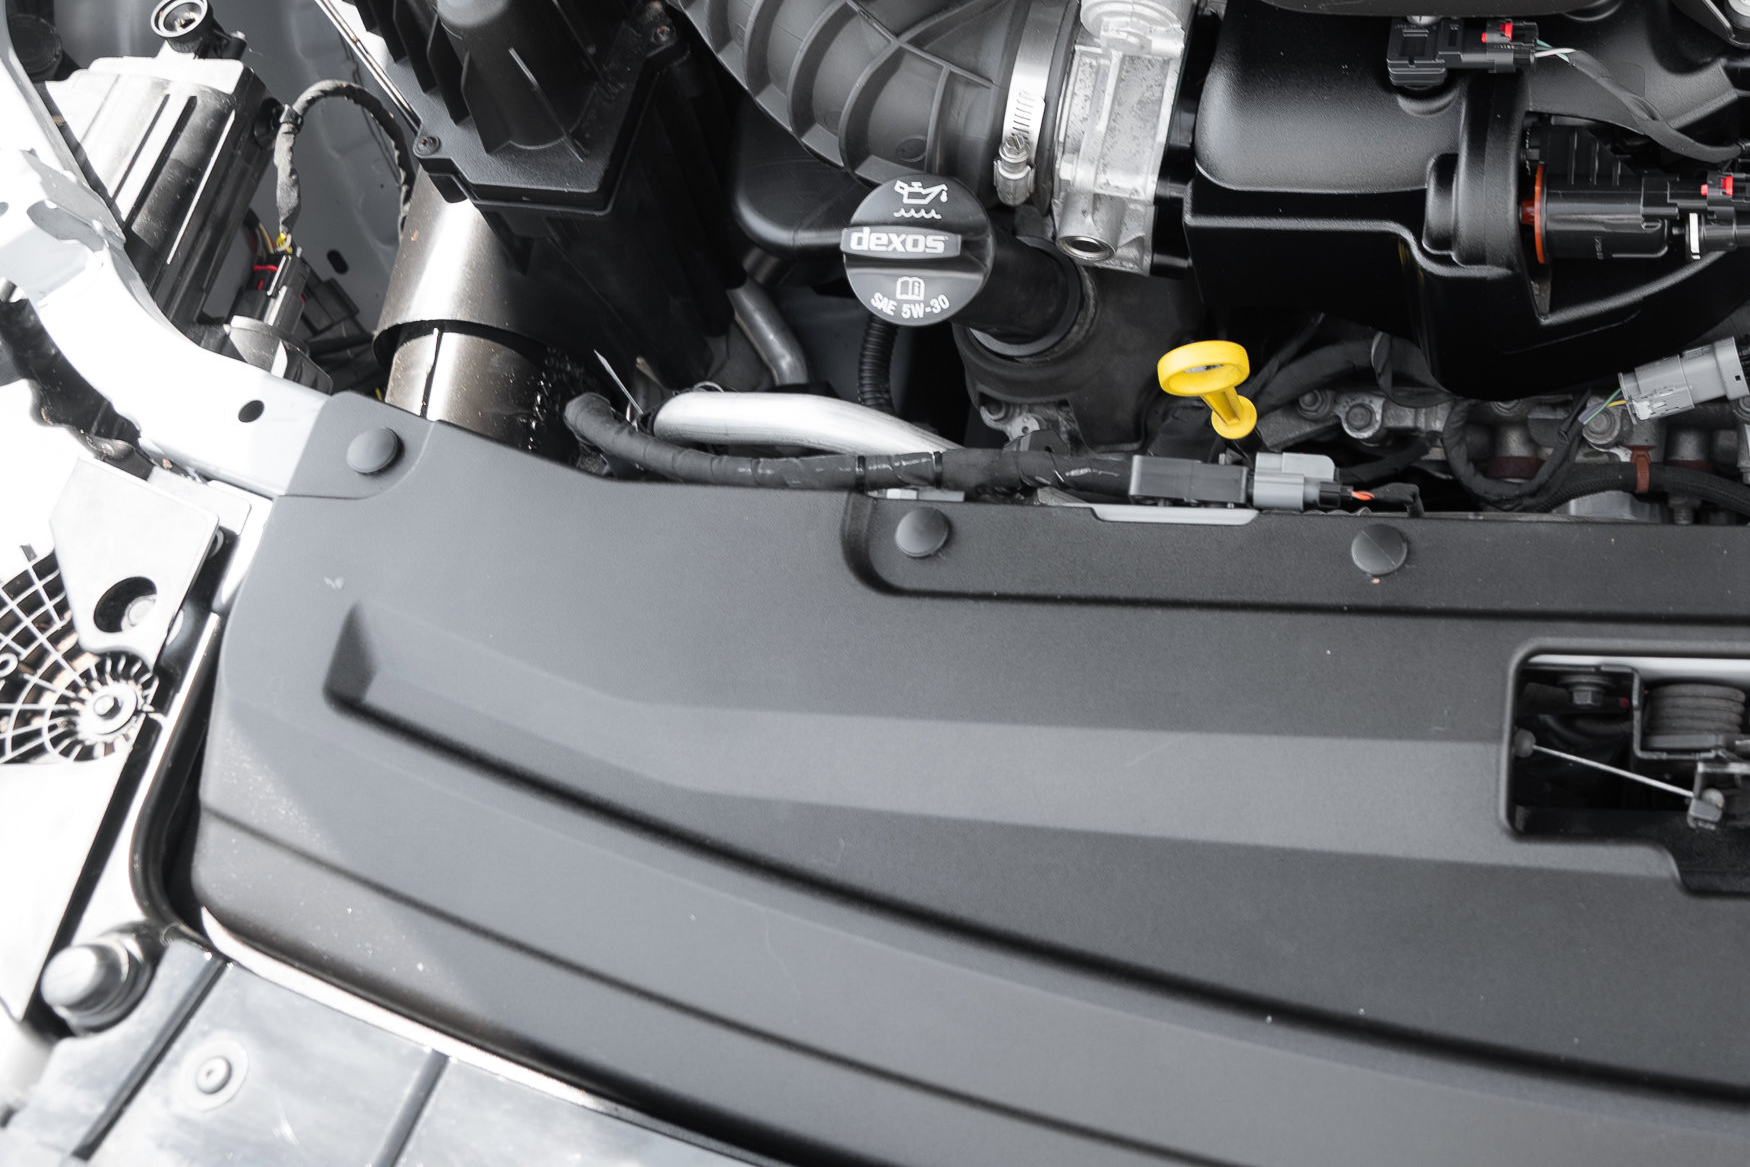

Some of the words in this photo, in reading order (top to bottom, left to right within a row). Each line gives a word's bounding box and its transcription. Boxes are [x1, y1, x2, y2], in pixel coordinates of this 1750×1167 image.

[850, 227, 945, 253] dexos
[871, 292, 897, 316] SAE
[901, 294, 950, 319] 5W-30
